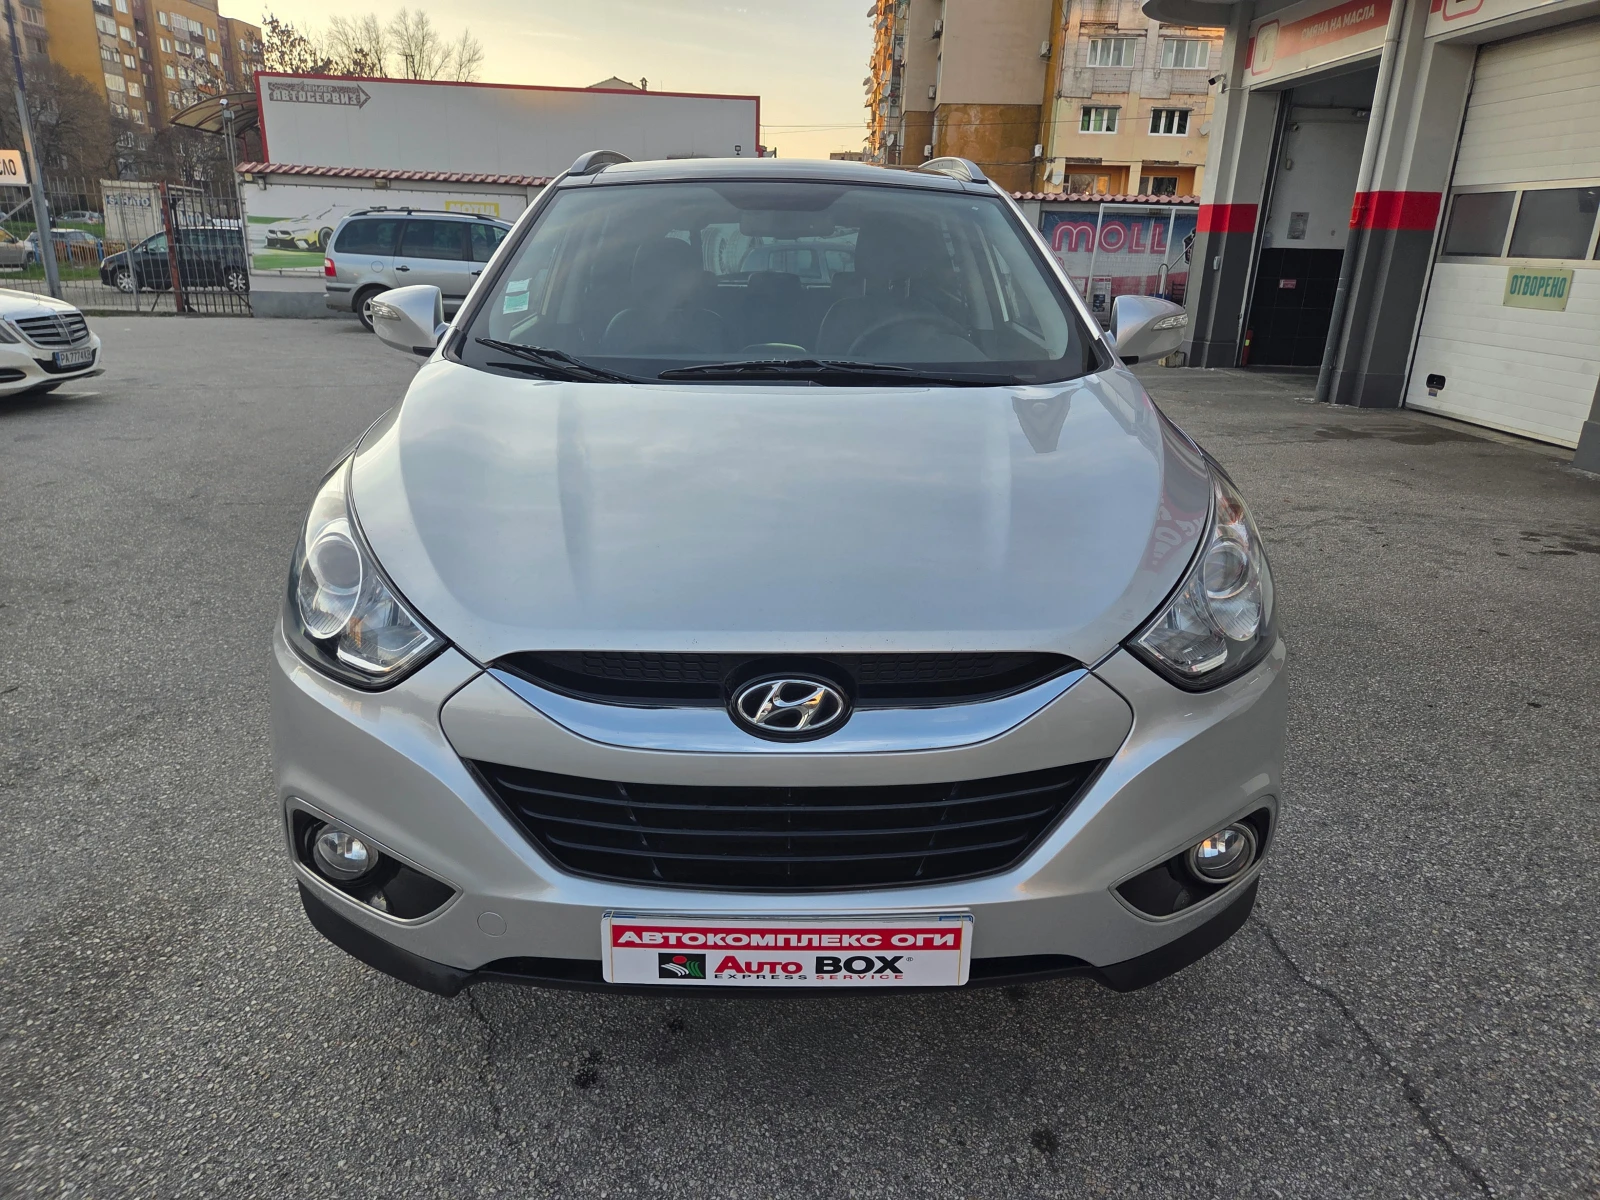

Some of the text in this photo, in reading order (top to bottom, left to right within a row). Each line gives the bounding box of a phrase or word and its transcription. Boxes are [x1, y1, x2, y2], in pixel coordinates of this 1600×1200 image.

[1301, 4, 1375, 40] СМЯНА НА МАСЛА
[272, 89, 358, 105] АВТОСЕРВИЗ
[1509, 275, 1567, 298] ОТВОРЕНО
[617, 931, 955, 947] АВТОКОМПЛЕКС ОГИ
